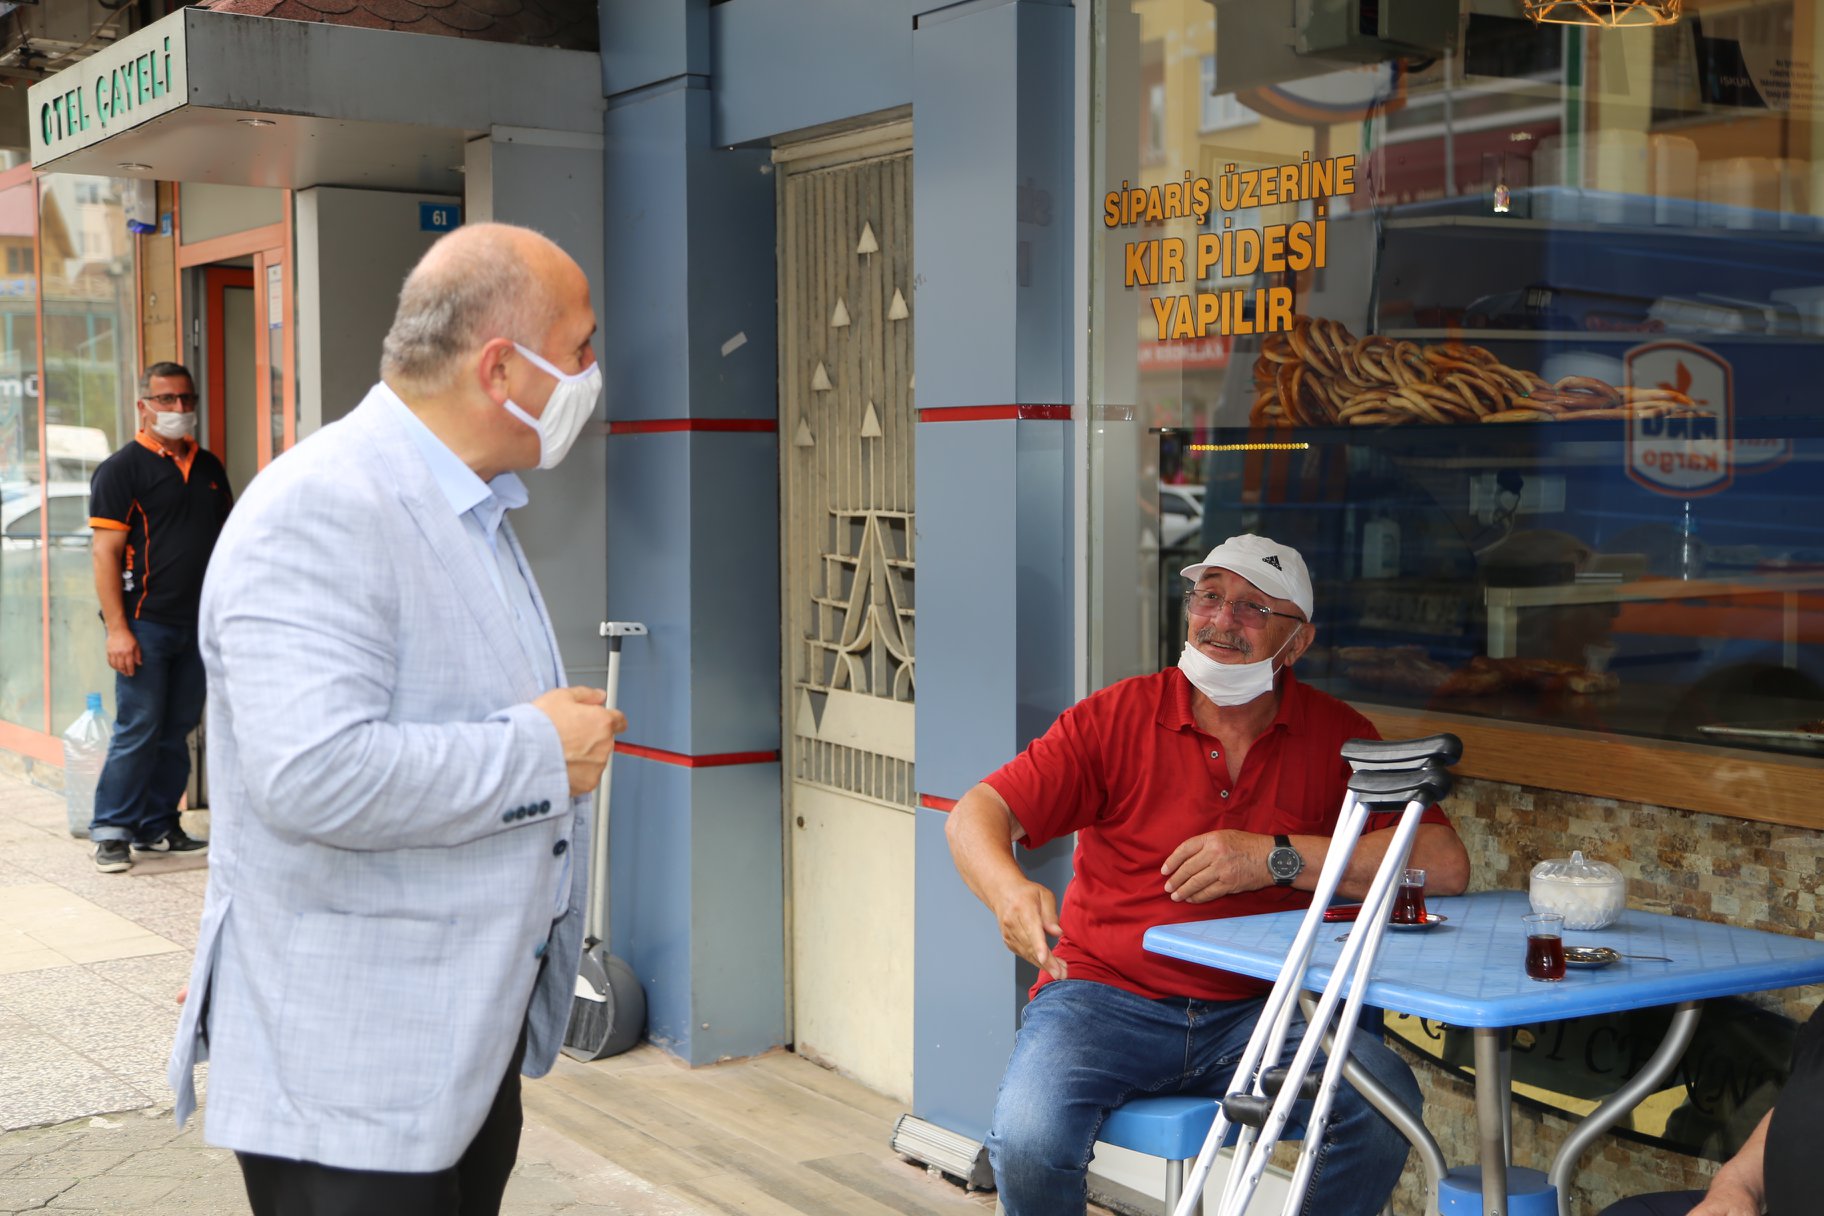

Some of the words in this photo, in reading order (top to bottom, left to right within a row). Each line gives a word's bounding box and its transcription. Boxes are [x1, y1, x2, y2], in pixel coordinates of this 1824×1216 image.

[41, 86, 91, 146] OTEL
[96, 36, 171, 128] ÇAYELİ
[433, 210, 447, 225] 61
[1104, 170, 1211, 227] SİPARİŞ
[1219, 151, 1356, 211] ÜZERİNE
[1125, 238, 1185, 287] KIR
[1197, 205, 1327, 280] PİDESİ
[1151, 286, 1293, 340] YAPILIR
